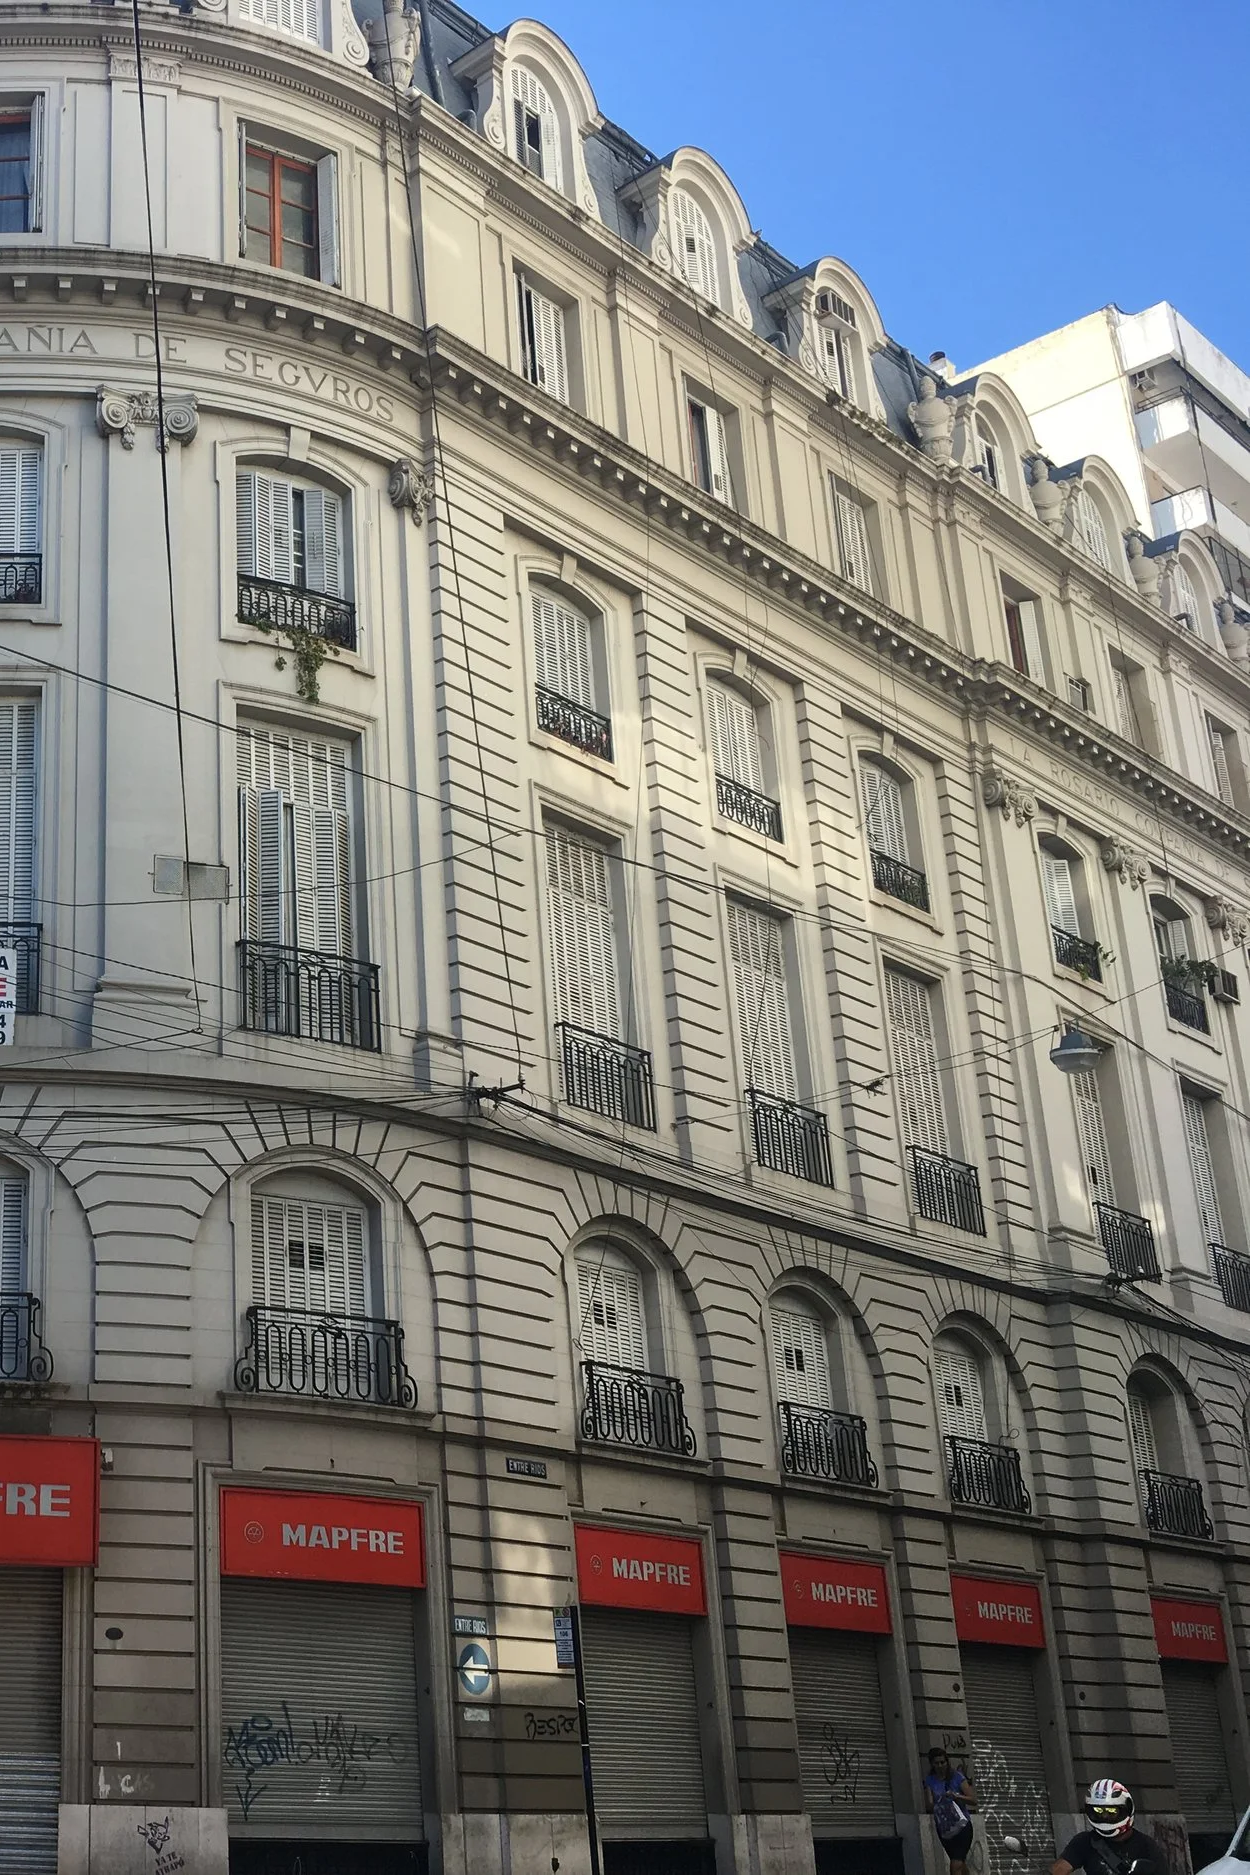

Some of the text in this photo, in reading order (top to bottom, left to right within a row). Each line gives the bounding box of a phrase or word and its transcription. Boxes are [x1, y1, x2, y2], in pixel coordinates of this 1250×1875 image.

[132, 333, 187, 364] DE
[223, 347, 395, 423] SEGVROS
[509, 1460, 529, 1473] ENTRE
[282, 1523, 404, 1554] MAPFRE
[612, 1557, 691, 1586] MAPFRE
[810, 1582, 879, 1608] MAPFRE
[977, 1600, 1034, 1625] MAPFRE
[454, 1618, 472, 1633] ENTRE
[1170, 1620, 1217, 1642] MAPFRE
